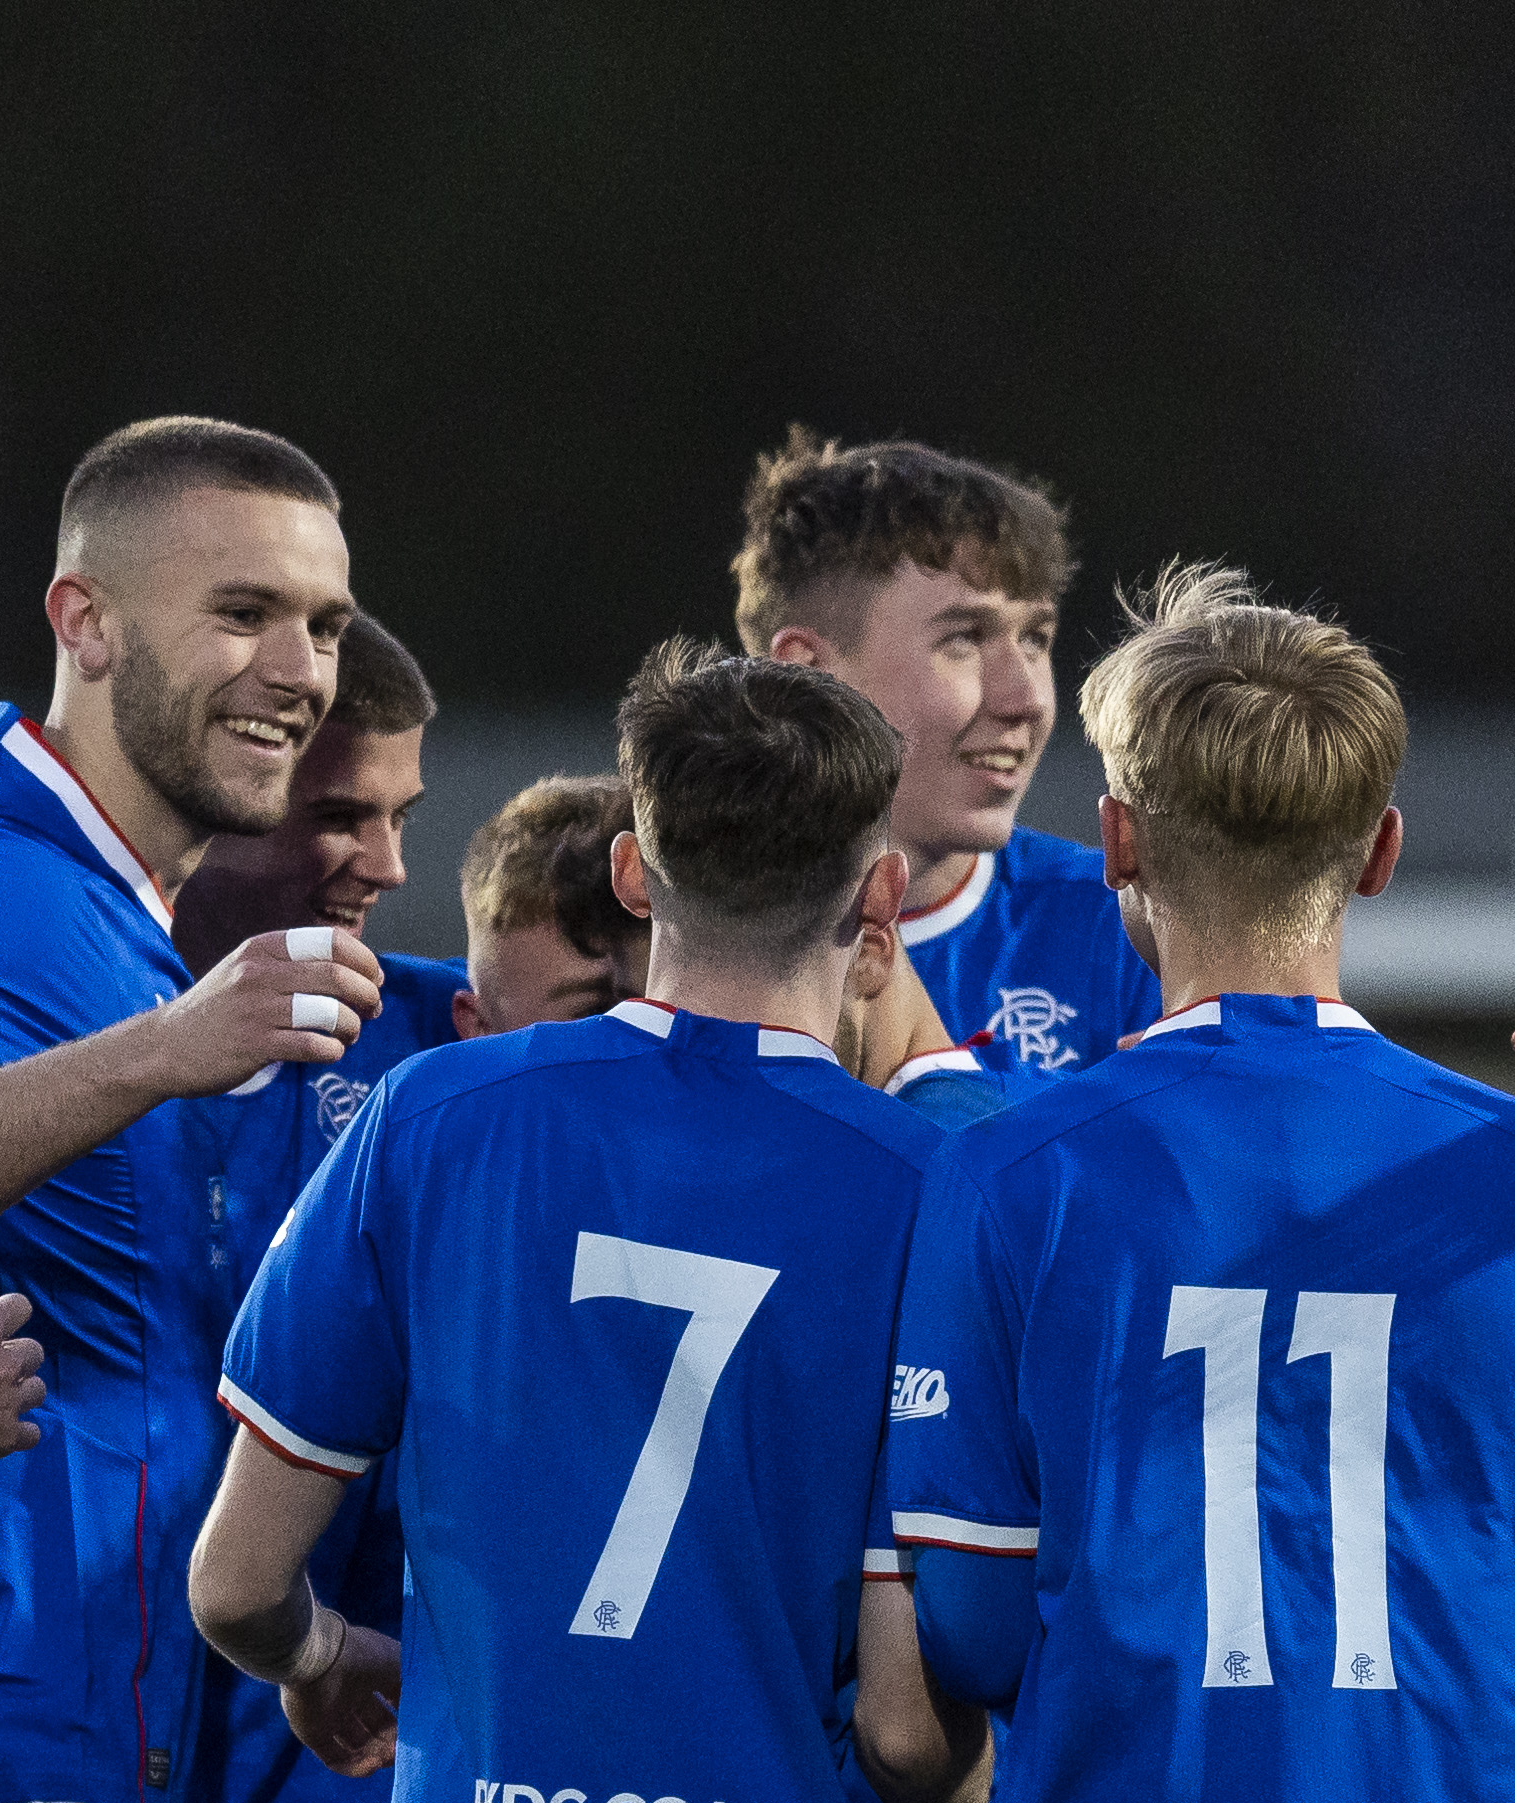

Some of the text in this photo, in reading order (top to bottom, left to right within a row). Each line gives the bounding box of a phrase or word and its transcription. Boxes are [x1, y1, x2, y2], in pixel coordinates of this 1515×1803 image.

[569, 1230, 781, 1640] 7
[890, 1364, 950, 1422] EKO
[1162, 1285, 1398, 1690] 11
